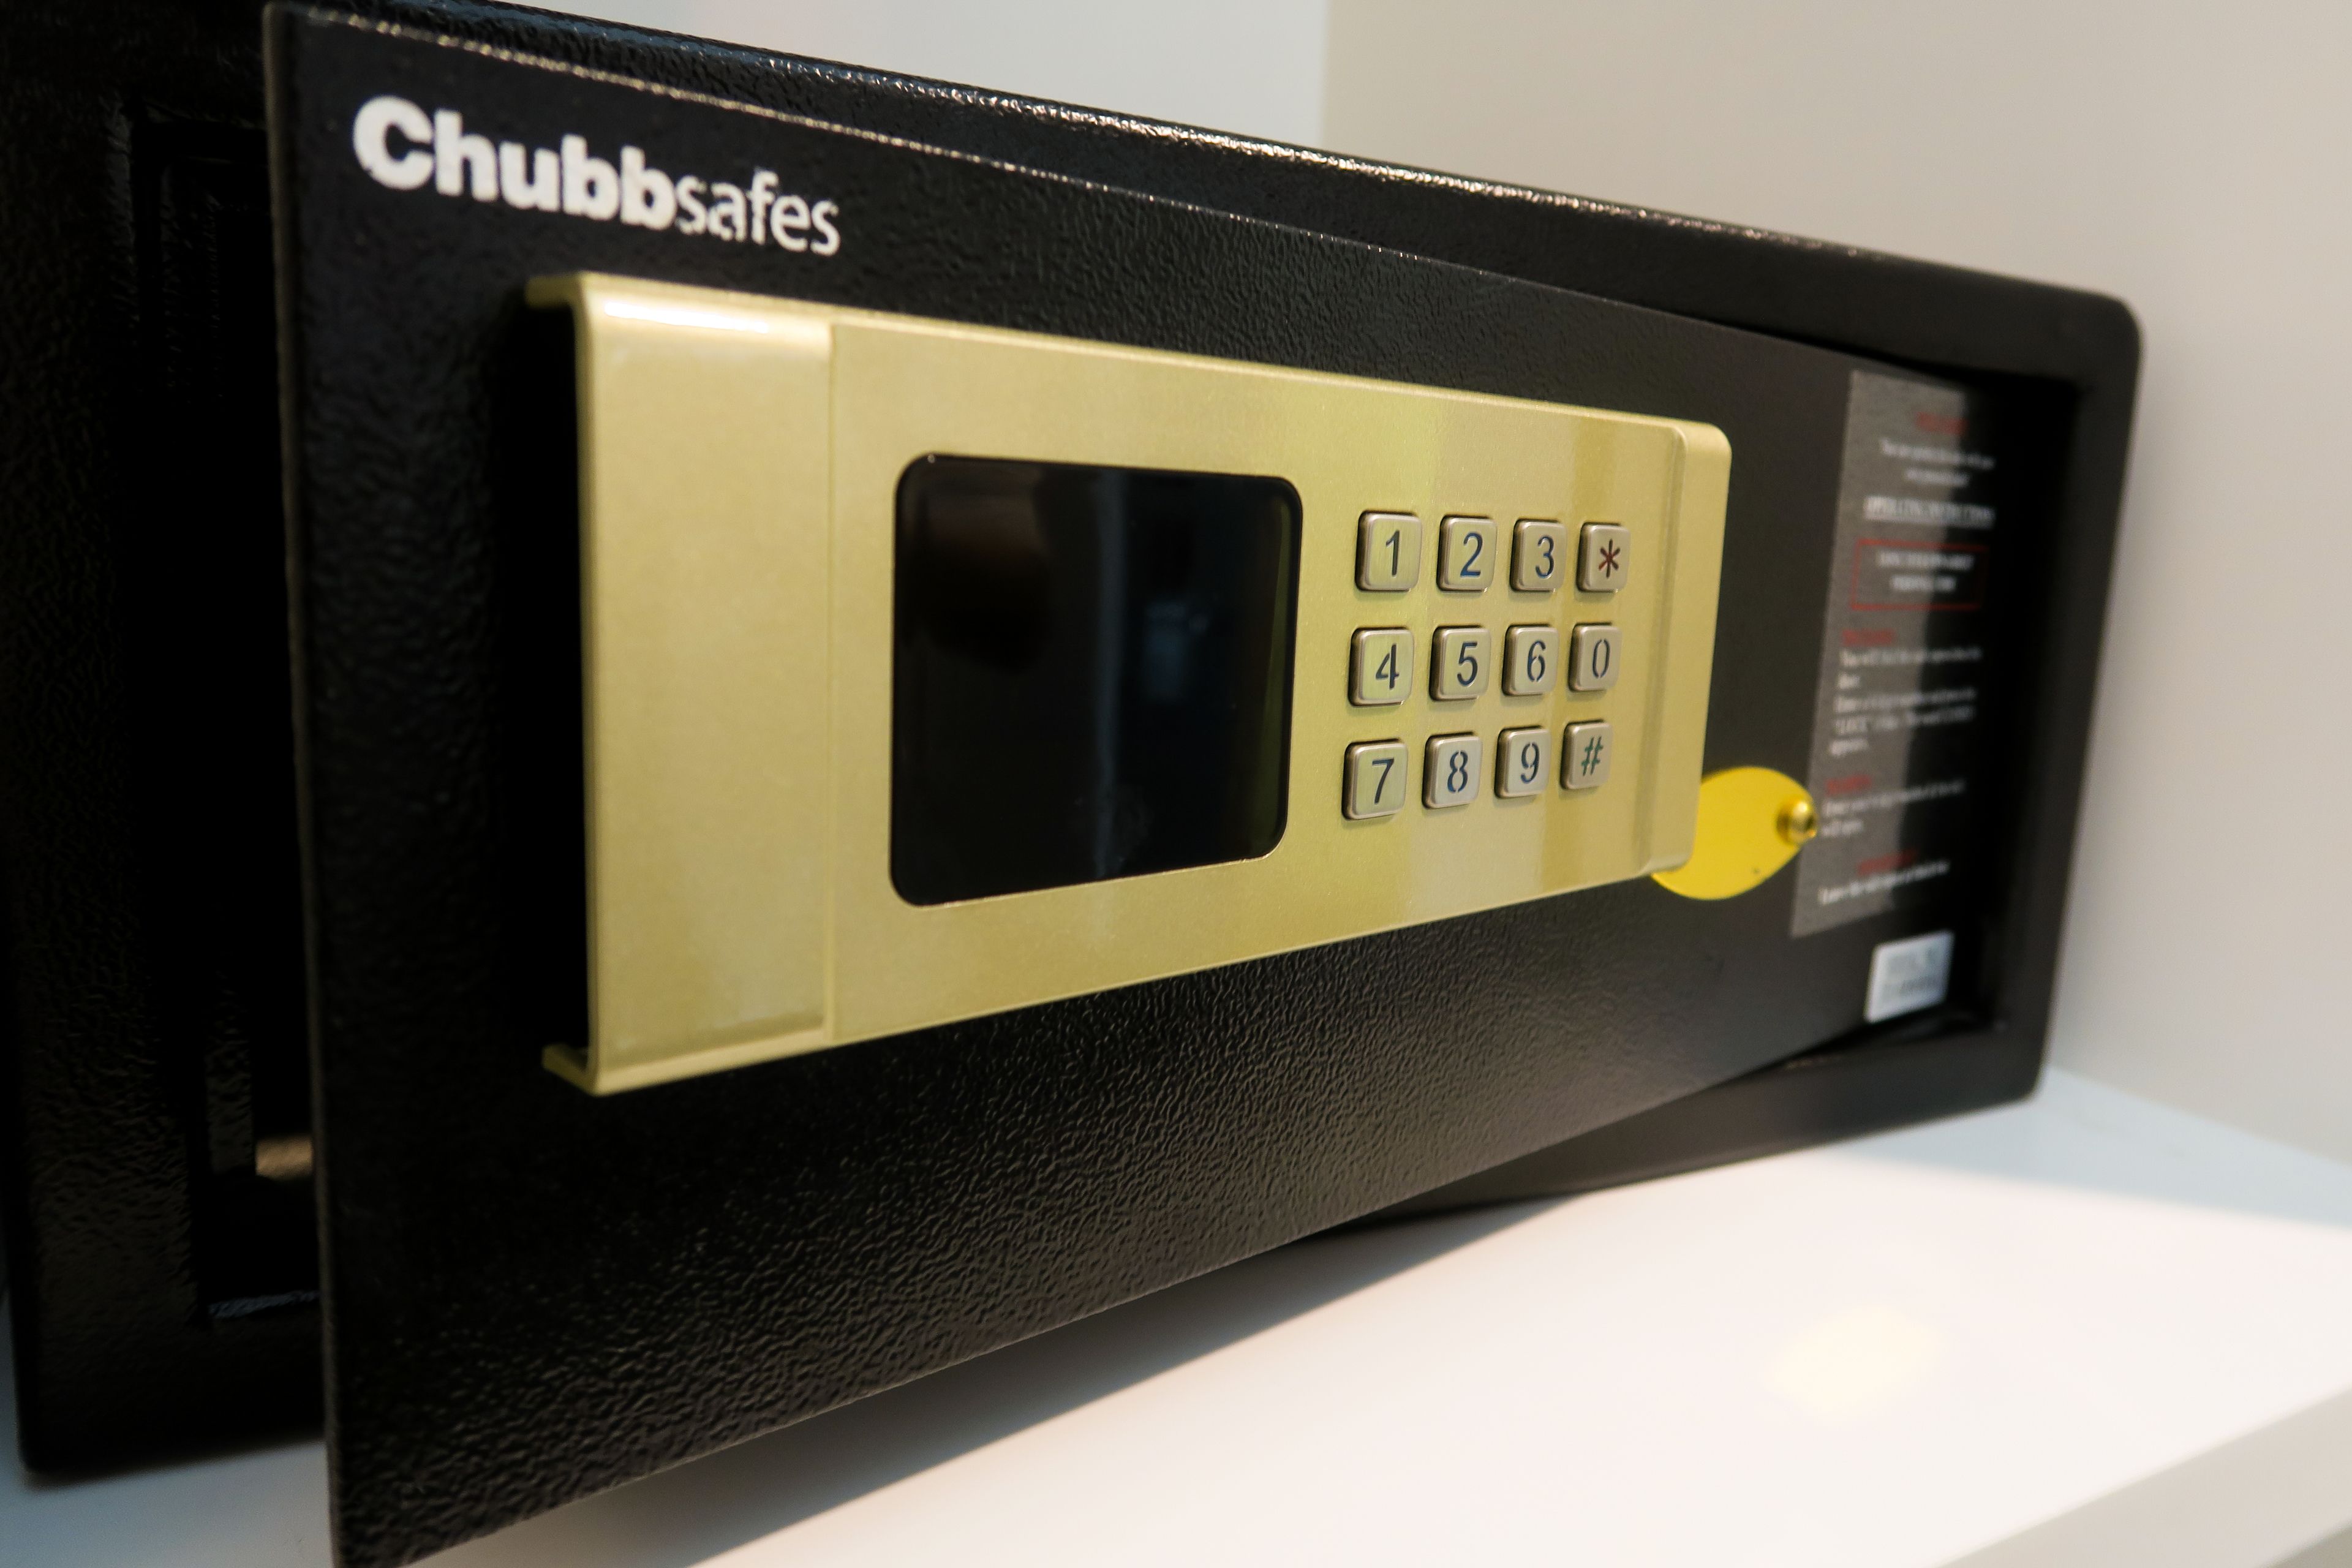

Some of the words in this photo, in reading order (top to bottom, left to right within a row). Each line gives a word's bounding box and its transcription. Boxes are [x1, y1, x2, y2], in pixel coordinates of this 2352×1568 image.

[353, 94, 840, 256] Chubbsafes
[1385, 529, 1401, 578] 1
[1460, 532, 1483, 579] 2
[1535, 535, 1555, 579] 3
[1375, 643, 1400, 690] 4
[1457, 641, 1479, 687] 5
[1526, 639, 1547, 682] 6
[1592, 639, 1611, 679] 0
[1447, 750, 1469, 794] 8
[1520, 741, 1540, 785] 9
[1581, 736, 1604, 777] #
[1371, 757, 1395, 805] 7
